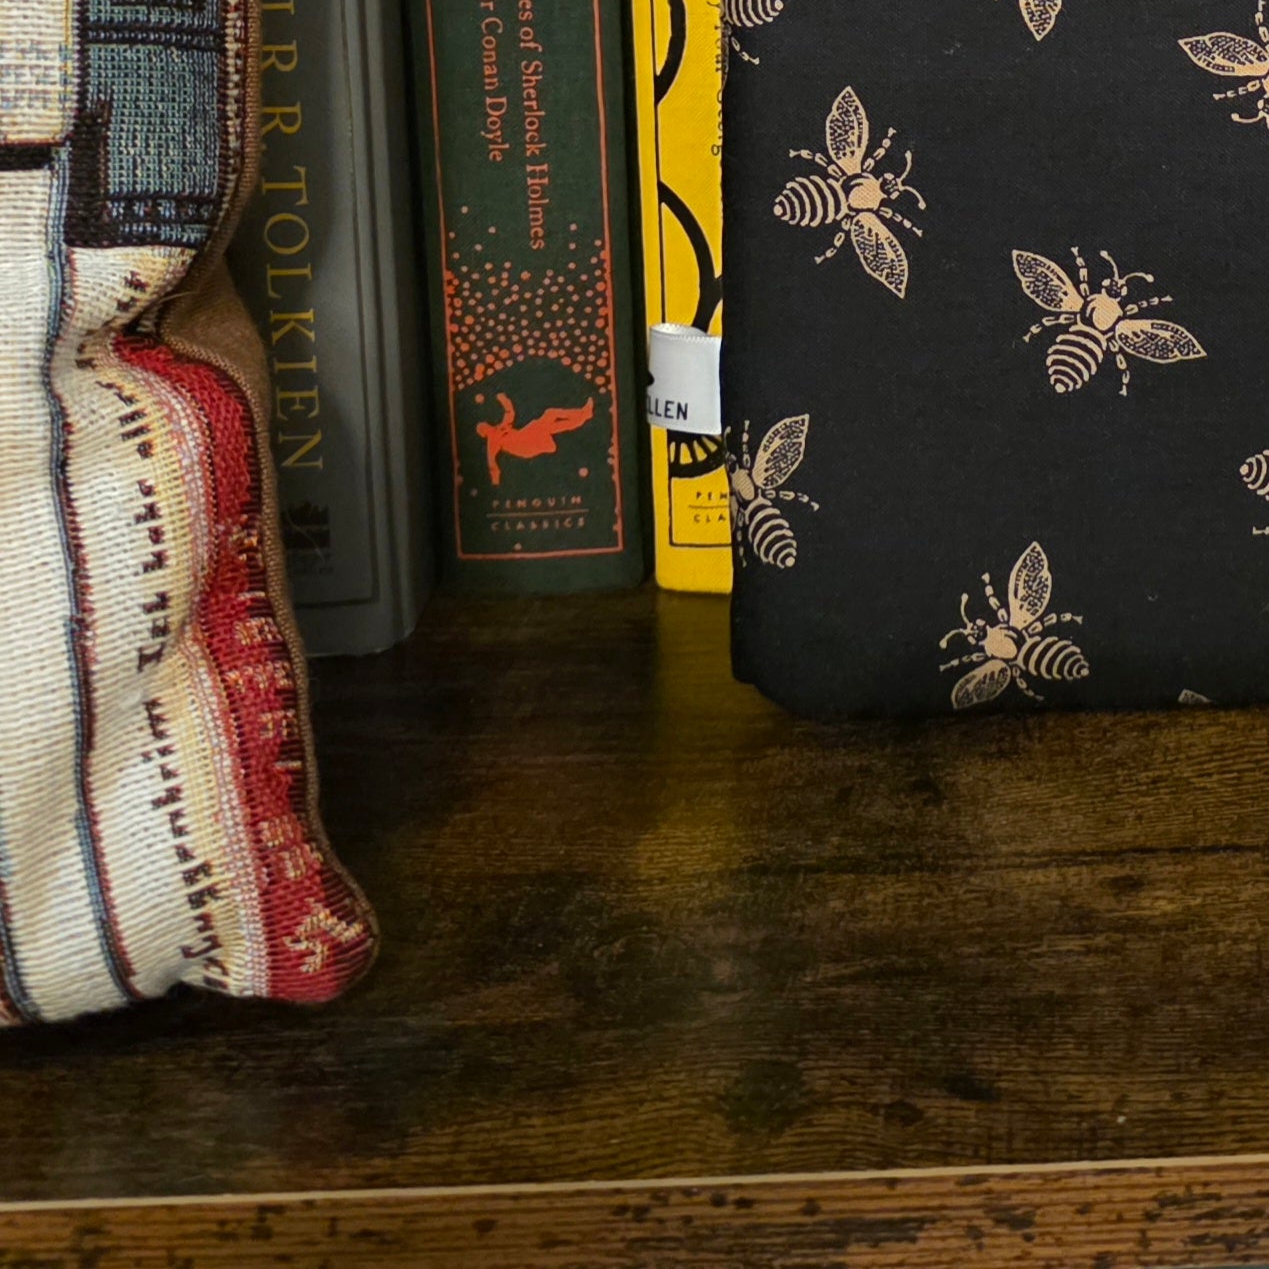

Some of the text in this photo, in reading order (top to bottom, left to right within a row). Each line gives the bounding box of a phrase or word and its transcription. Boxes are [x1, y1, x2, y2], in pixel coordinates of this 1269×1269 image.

[480, 17, 503, 90] Conan
[519, 25, 542, 51] of
[480, 96, 508, 162] Doyle
[521, 60, 546, 158] Sherlock
[527, 163, 550, 250] Holmes
[262, 165, 323, 470] TOLKIEN
[646, 395, 688, 420] LLEN
[491, 516, 585, 531] CLASSICS
[492, 494, 582, 508] PENGUIN
[693, 513, 727, 525] CLA
